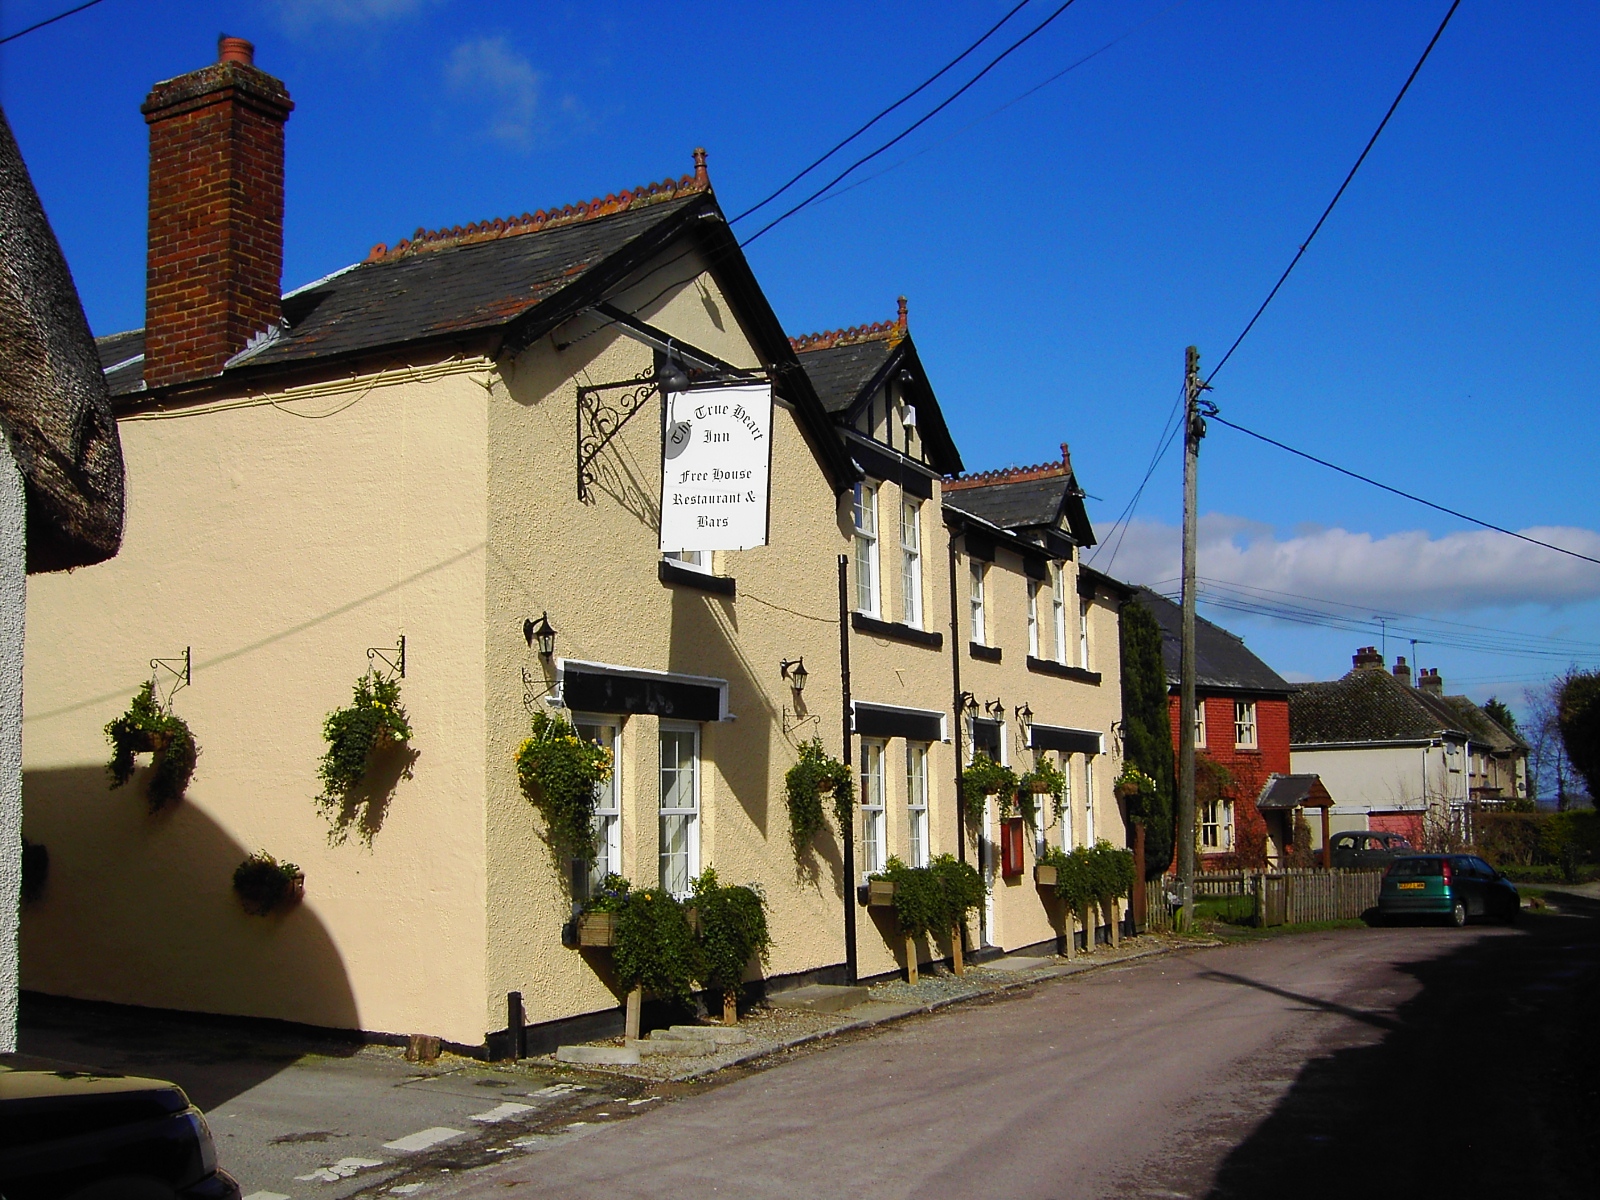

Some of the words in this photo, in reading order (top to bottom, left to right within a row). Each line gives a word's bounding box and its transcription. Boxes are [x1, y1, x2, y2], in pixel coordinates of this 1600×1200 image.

[670, 419, 693, 445] The
[693, 404, 730, 420] True
[730, 403, 764, 441] Heart
[703, 429, 730, 444] Inn
[678, 469, 709, 484] Free
[711, 468, 752, 483] House
[672, 493, 741, 505] Restaurant
[744, 490, 756, 503] &
[696, 515, 729, 530] Bars
